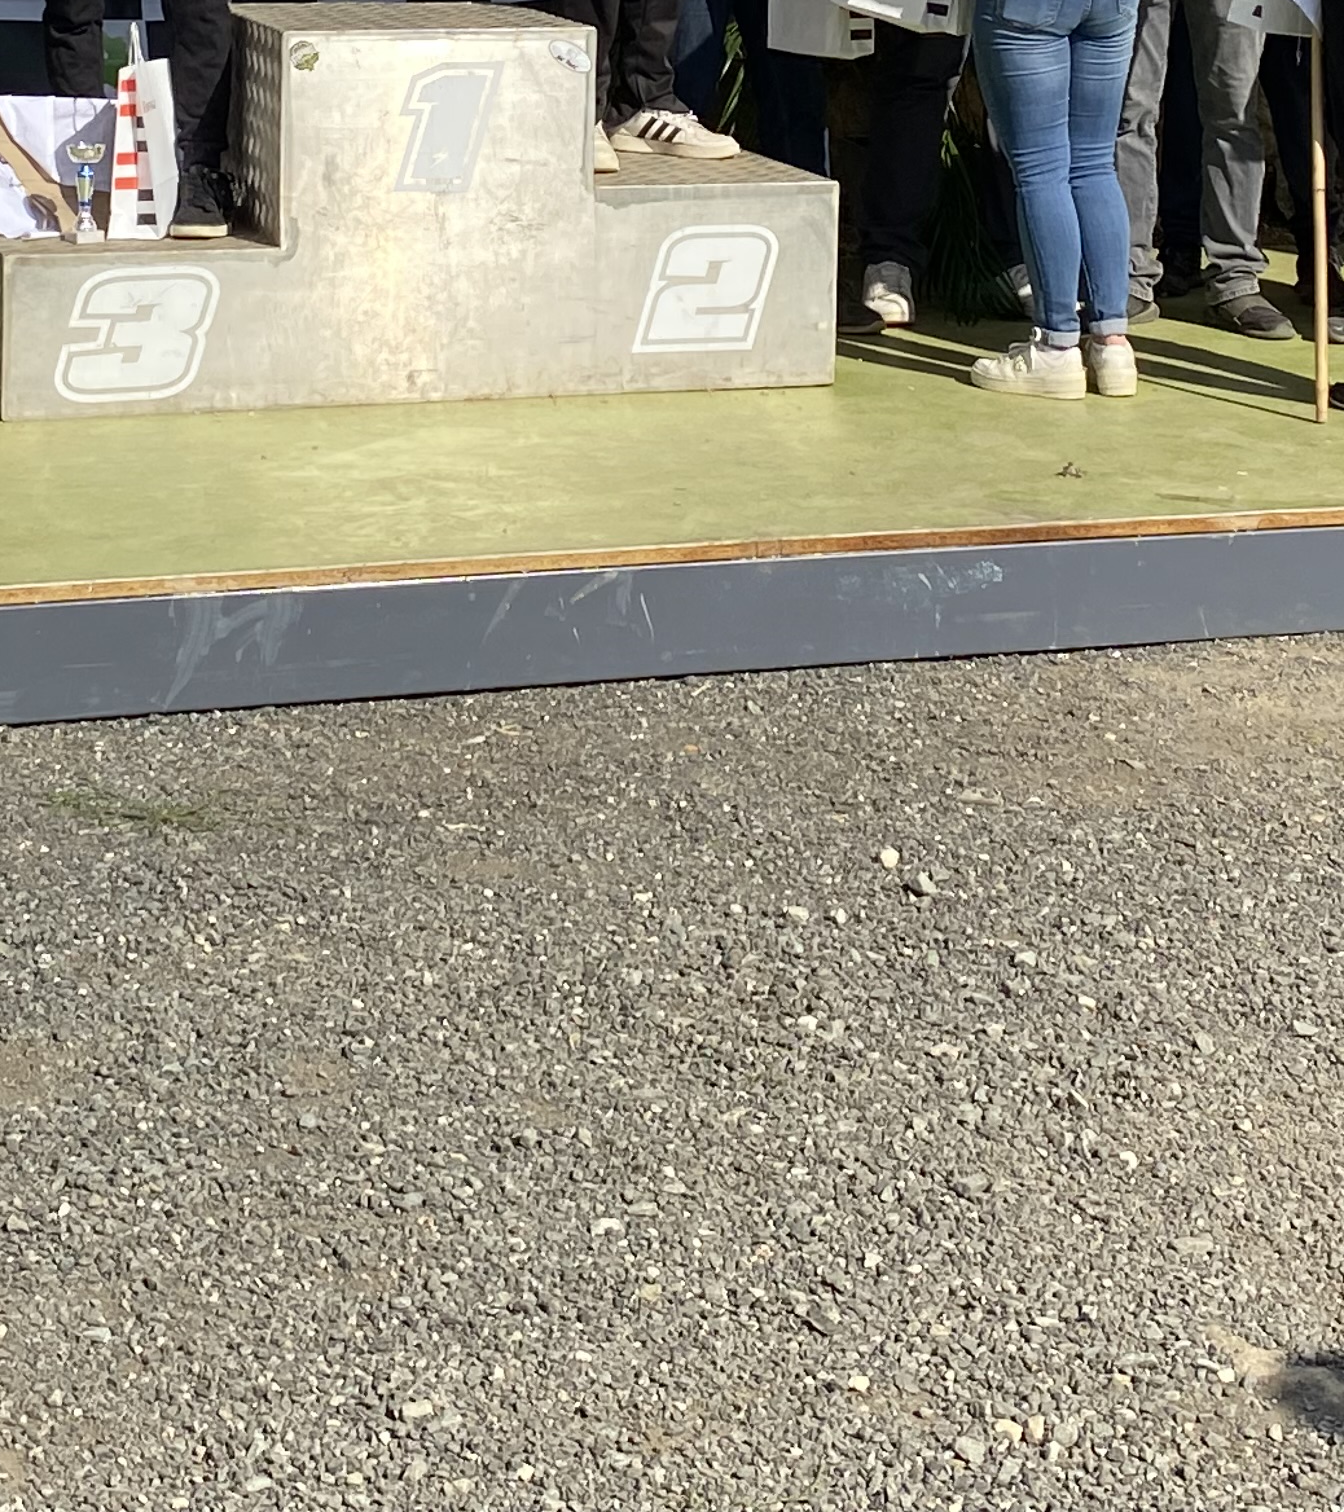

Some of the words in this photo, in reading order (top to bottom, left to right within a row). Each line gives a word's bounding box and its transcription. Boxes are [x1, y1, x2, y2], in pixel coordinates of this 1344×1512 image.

[393, 61, 504, 193] 1
[54, 264, 220, 405] 3
[632, 223, 780, 354] 2
